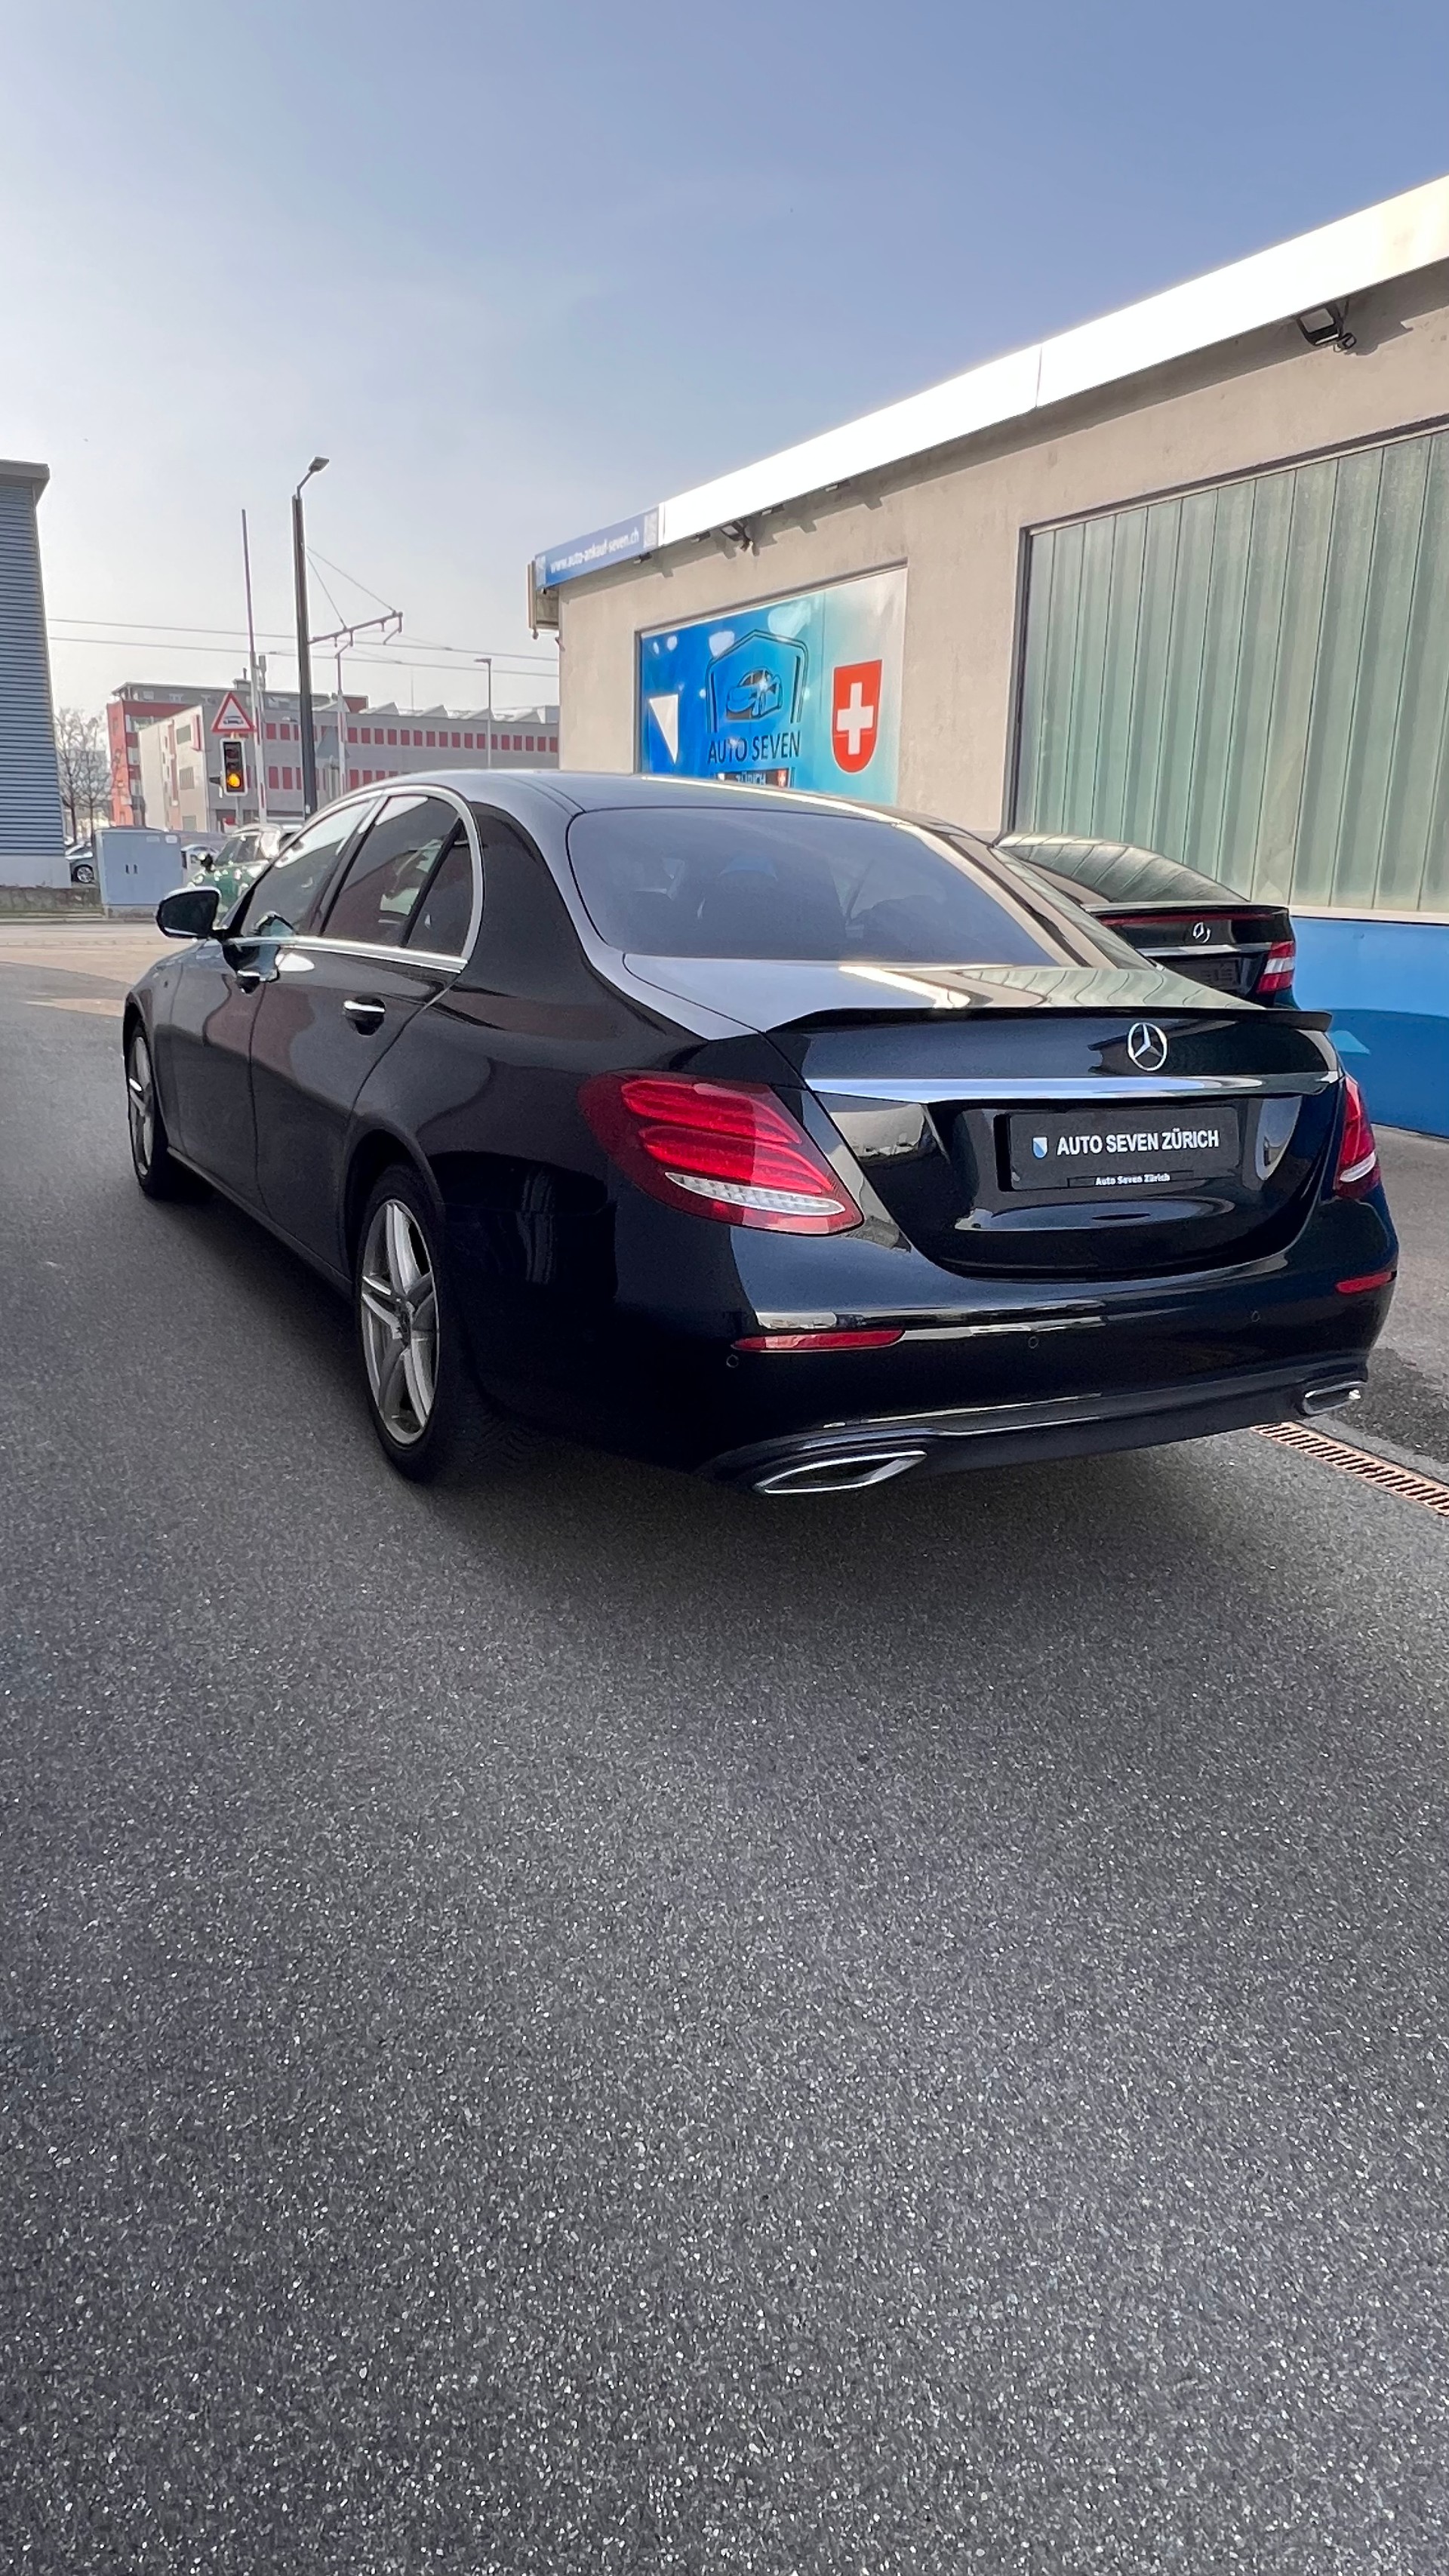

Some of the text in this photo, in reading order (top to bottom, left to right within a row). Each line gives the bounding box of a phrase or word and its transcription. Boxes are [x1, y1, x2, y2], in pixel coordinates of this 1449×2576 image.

[708, 731, 800, 764] AUTO SEVEN
[1057, 1128, 1220, 1156] AUTO SEVEN ZÜRICH
[1095, 1173, 1171, 1186] Auto Seven Zürich
